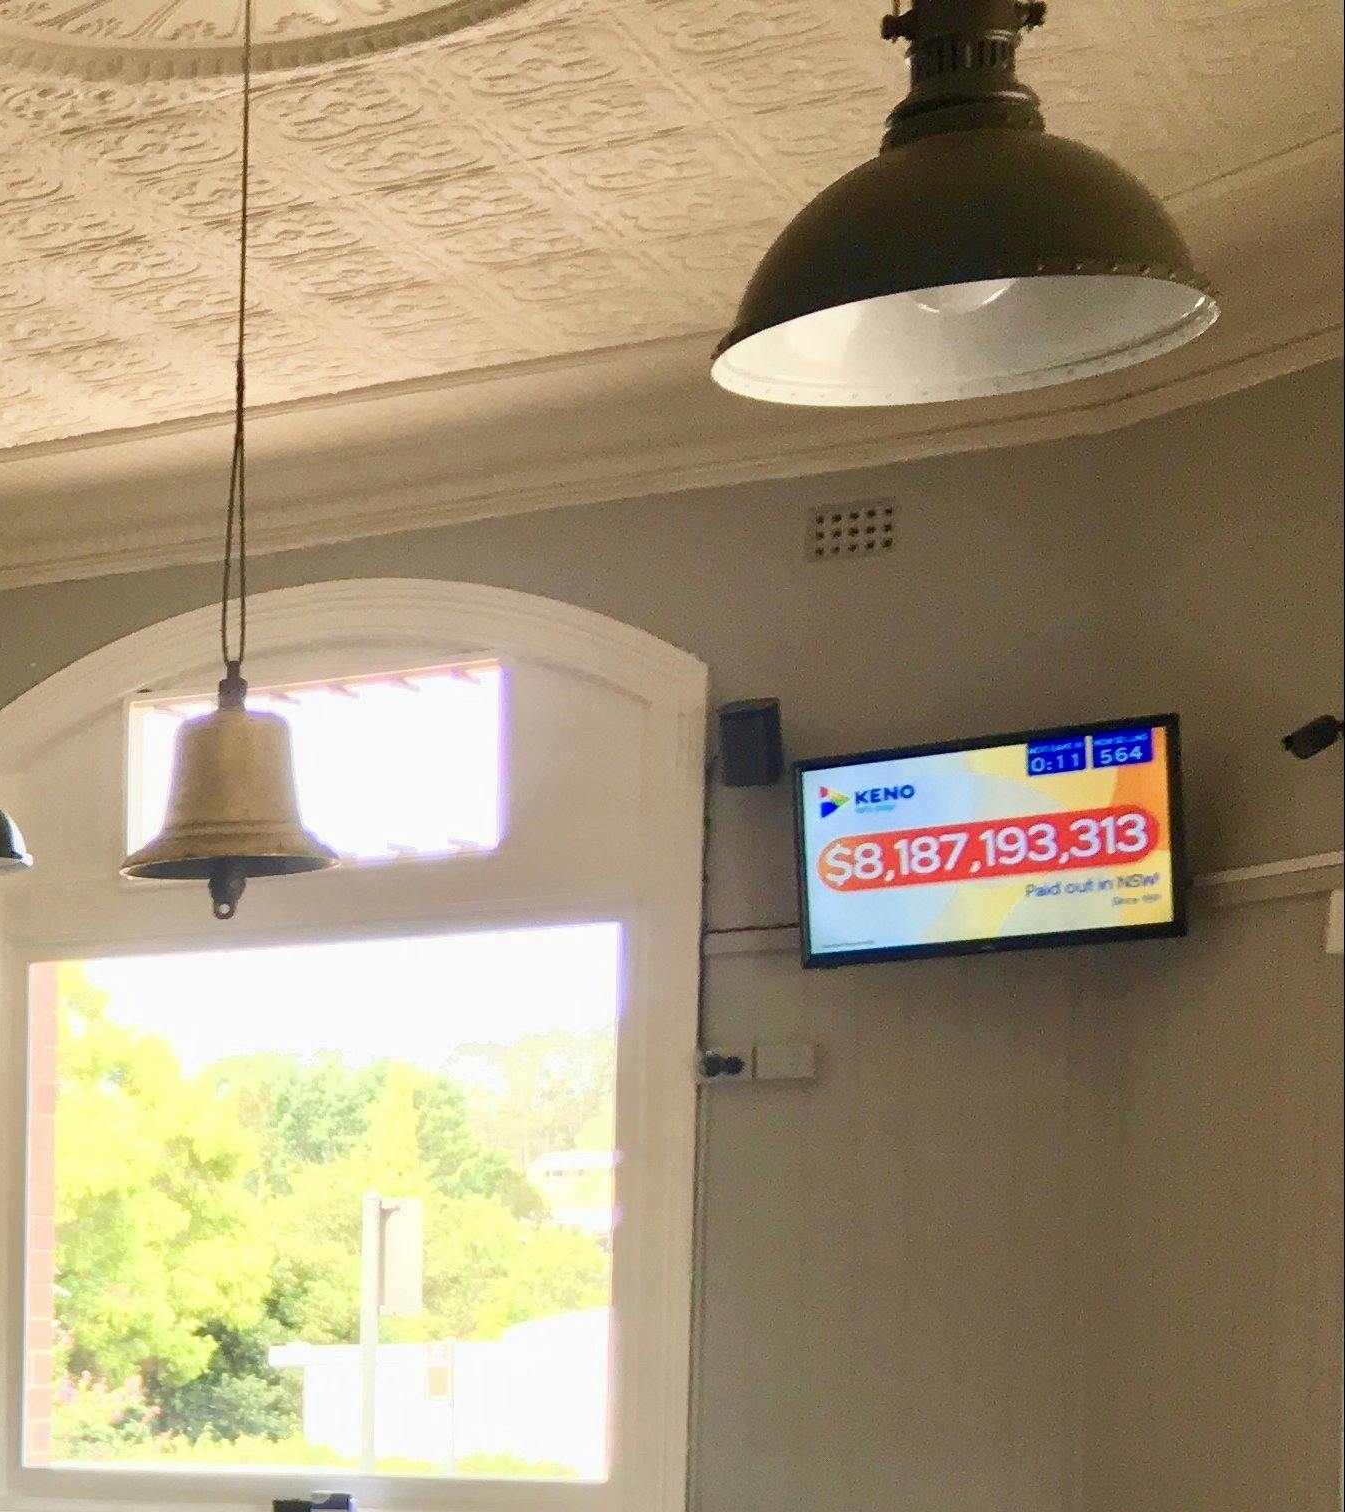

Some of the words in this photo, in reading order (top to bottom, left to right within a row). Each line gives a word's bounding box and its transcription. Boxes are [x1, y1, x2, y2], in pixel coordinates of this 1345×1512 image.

[1031, 753, 1079, 772] 0:11
[1100, 746, 1143, 764] 564
[855, 784, 915, 804] KENO
[824, 811, 1150, 888] $8,187,193,313
[1025, 880, 1061, 897] Paid
[1064, 878, 1093, 894] out
